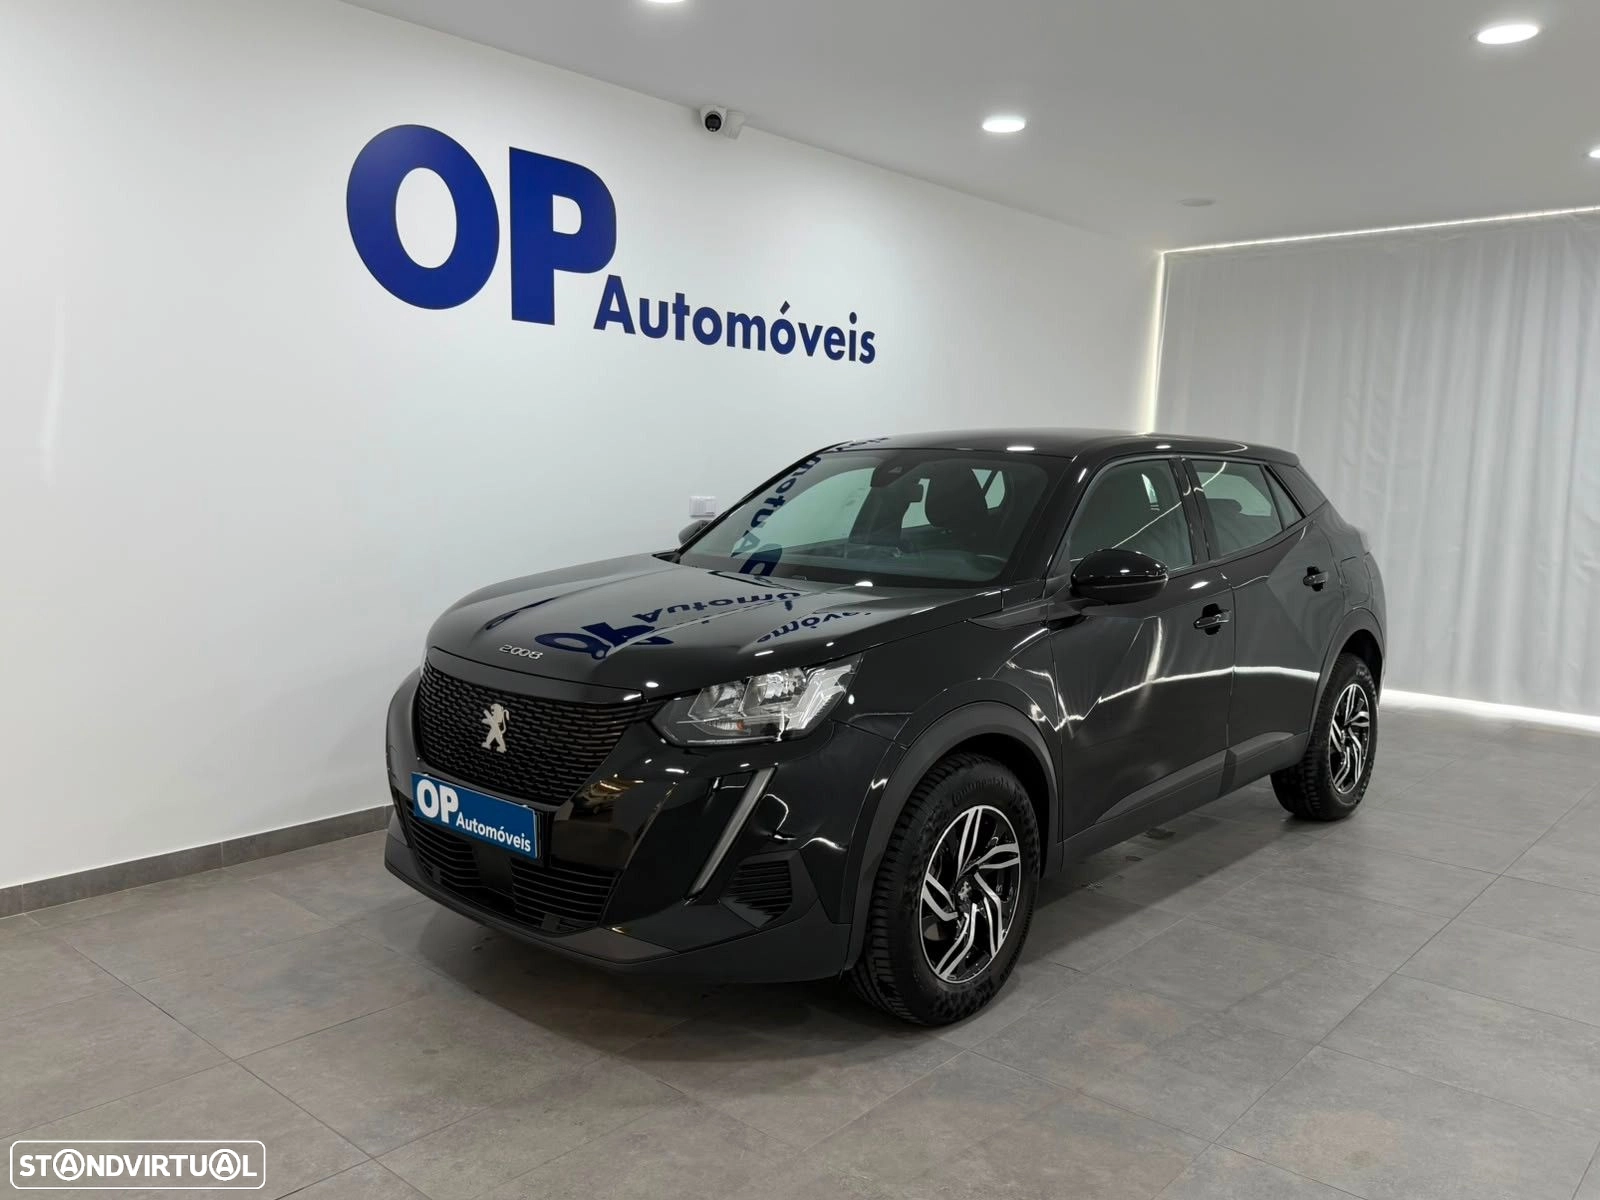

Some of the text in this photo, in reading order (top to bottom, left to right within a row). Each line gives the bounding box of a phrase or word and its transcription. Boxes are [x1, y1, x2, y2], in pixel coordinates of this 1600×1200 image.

[346, 124, 876, 364] OP Automóveis
[499, 644, 543, 660] 2008
[416, 779, 531, 852] OP Automóveis
